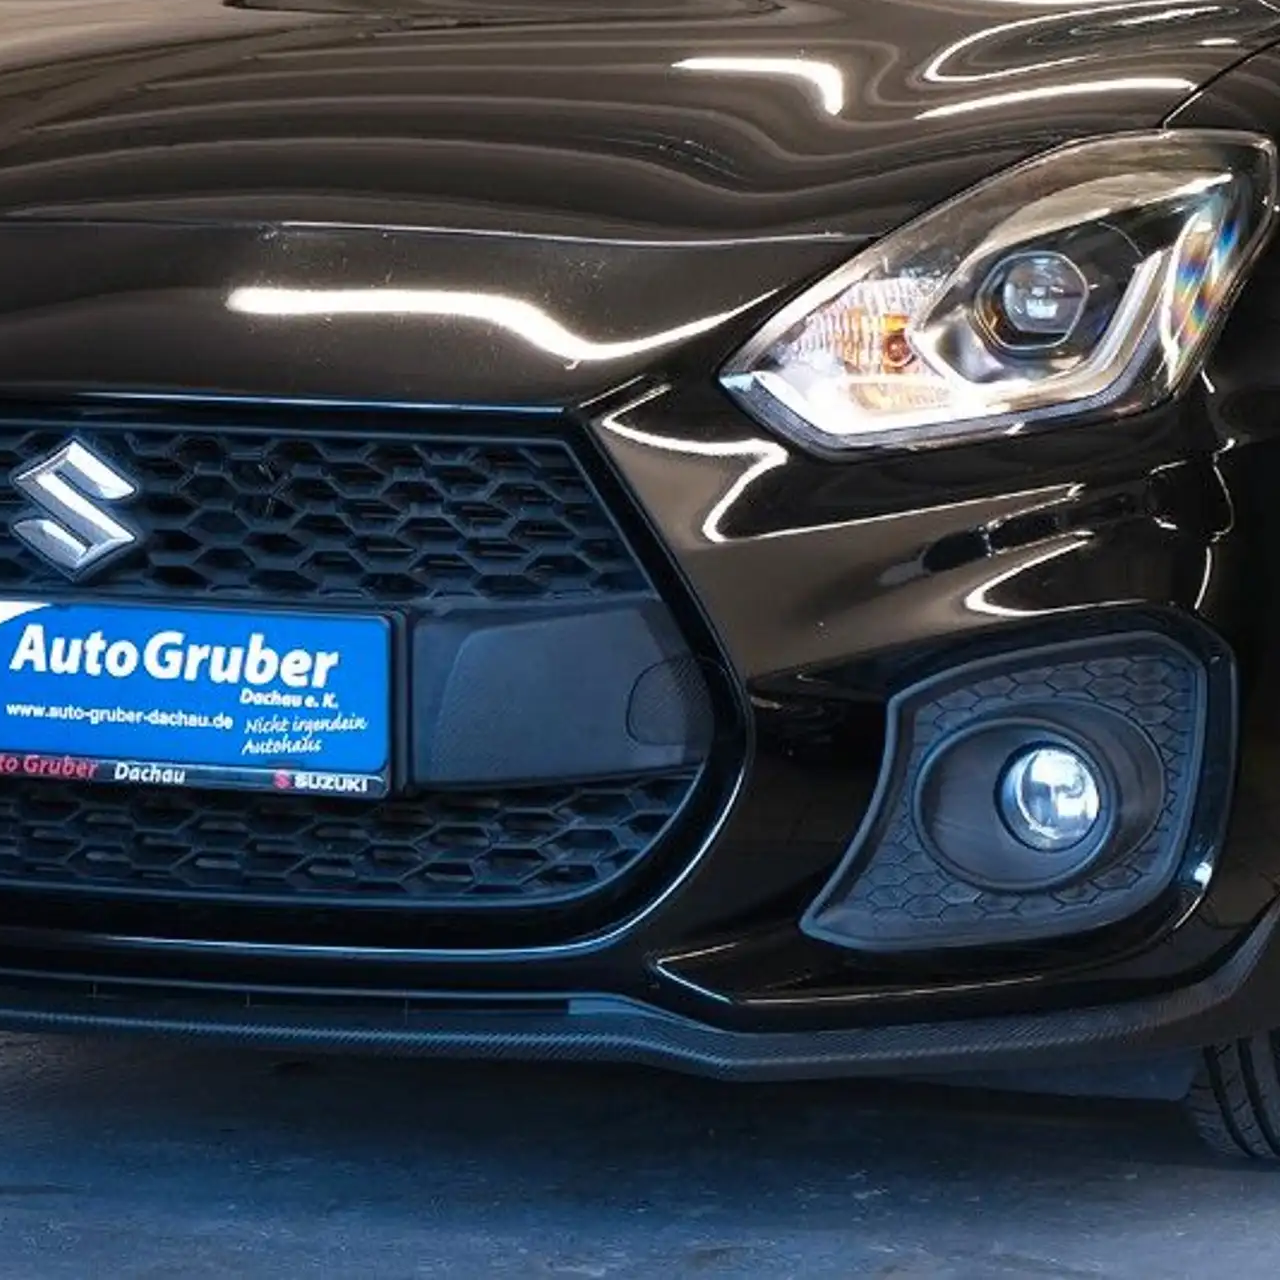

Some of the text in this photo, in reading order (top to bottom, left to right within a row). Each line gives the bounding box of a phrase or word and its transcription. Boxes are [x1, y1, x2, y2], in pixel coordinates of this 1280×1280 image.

[240, 687, 303, 708] Dachau
[6, 702, 234, 730] www.auto-gruber-dachau.de
[244, 711, 369, 738] Nicht irgendein
[241, 733, 322, 756] Autohaus
[23, 753, 99, 779] Gruber
[113, 761, 187, 784] Dachau
[293, 773, 369, 793] SUZUKI
